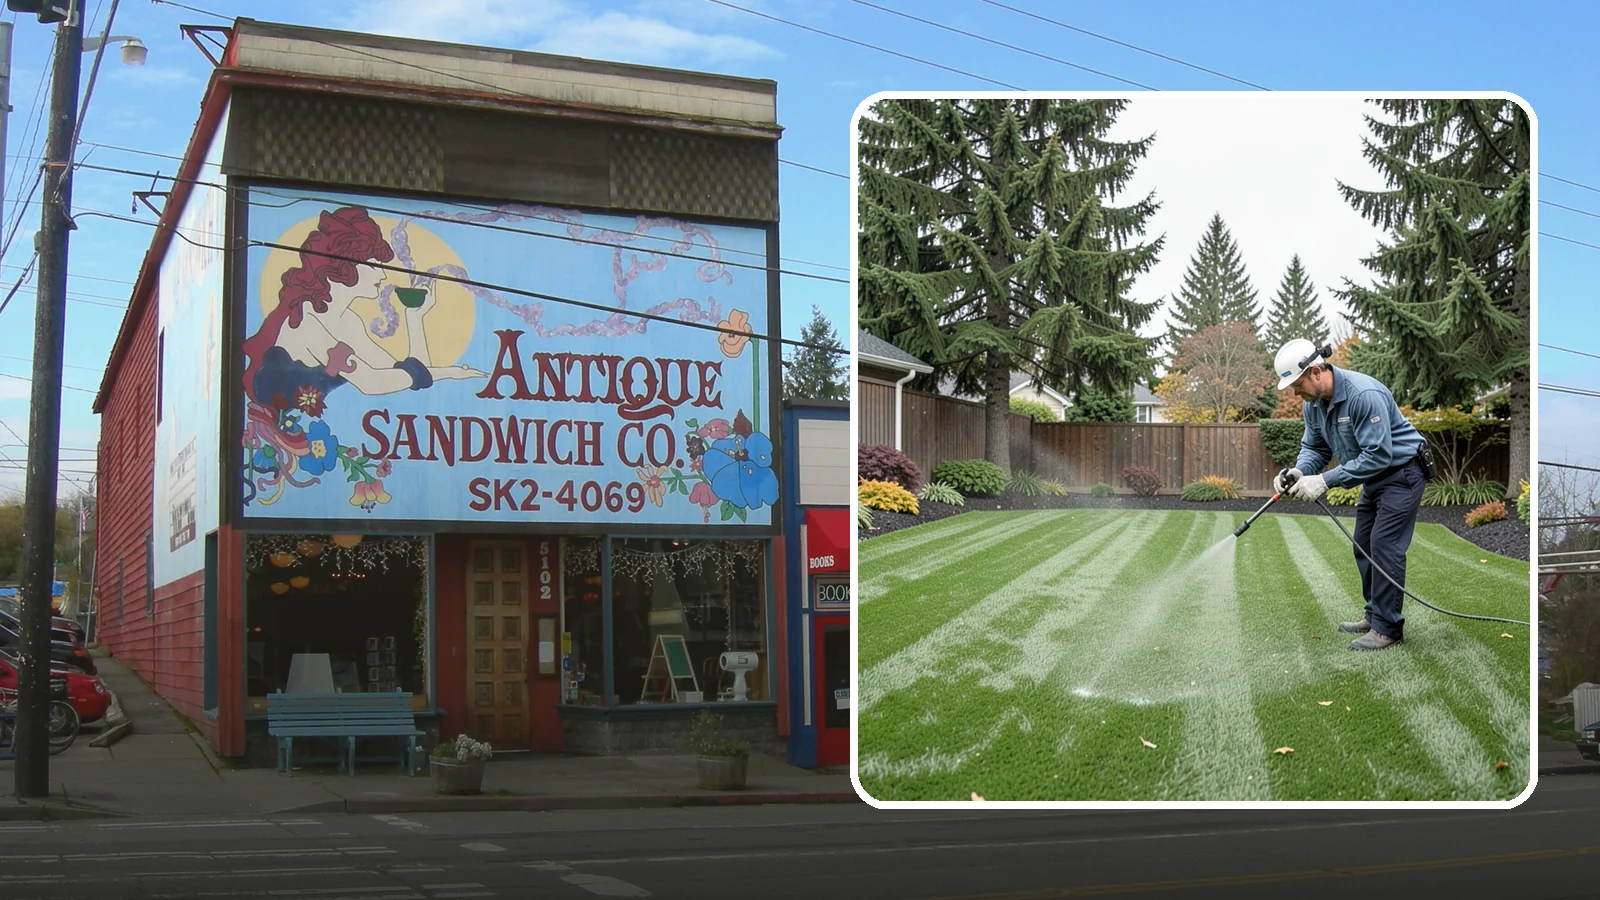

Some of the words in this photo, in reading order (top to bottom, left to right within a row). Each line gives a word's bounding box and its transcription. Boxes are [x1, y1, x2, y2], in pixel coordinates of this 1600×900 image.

[475, 329, 723, 421] ANTIQUE
[361, 408, 605, 468] SANDWICH
[616, 422, 684, 469] CO.
[468, 477, 646, 512] SK2-4069
[539, 542, 551, 600] 5102
[809, 555, 835, 569] BOOKS
